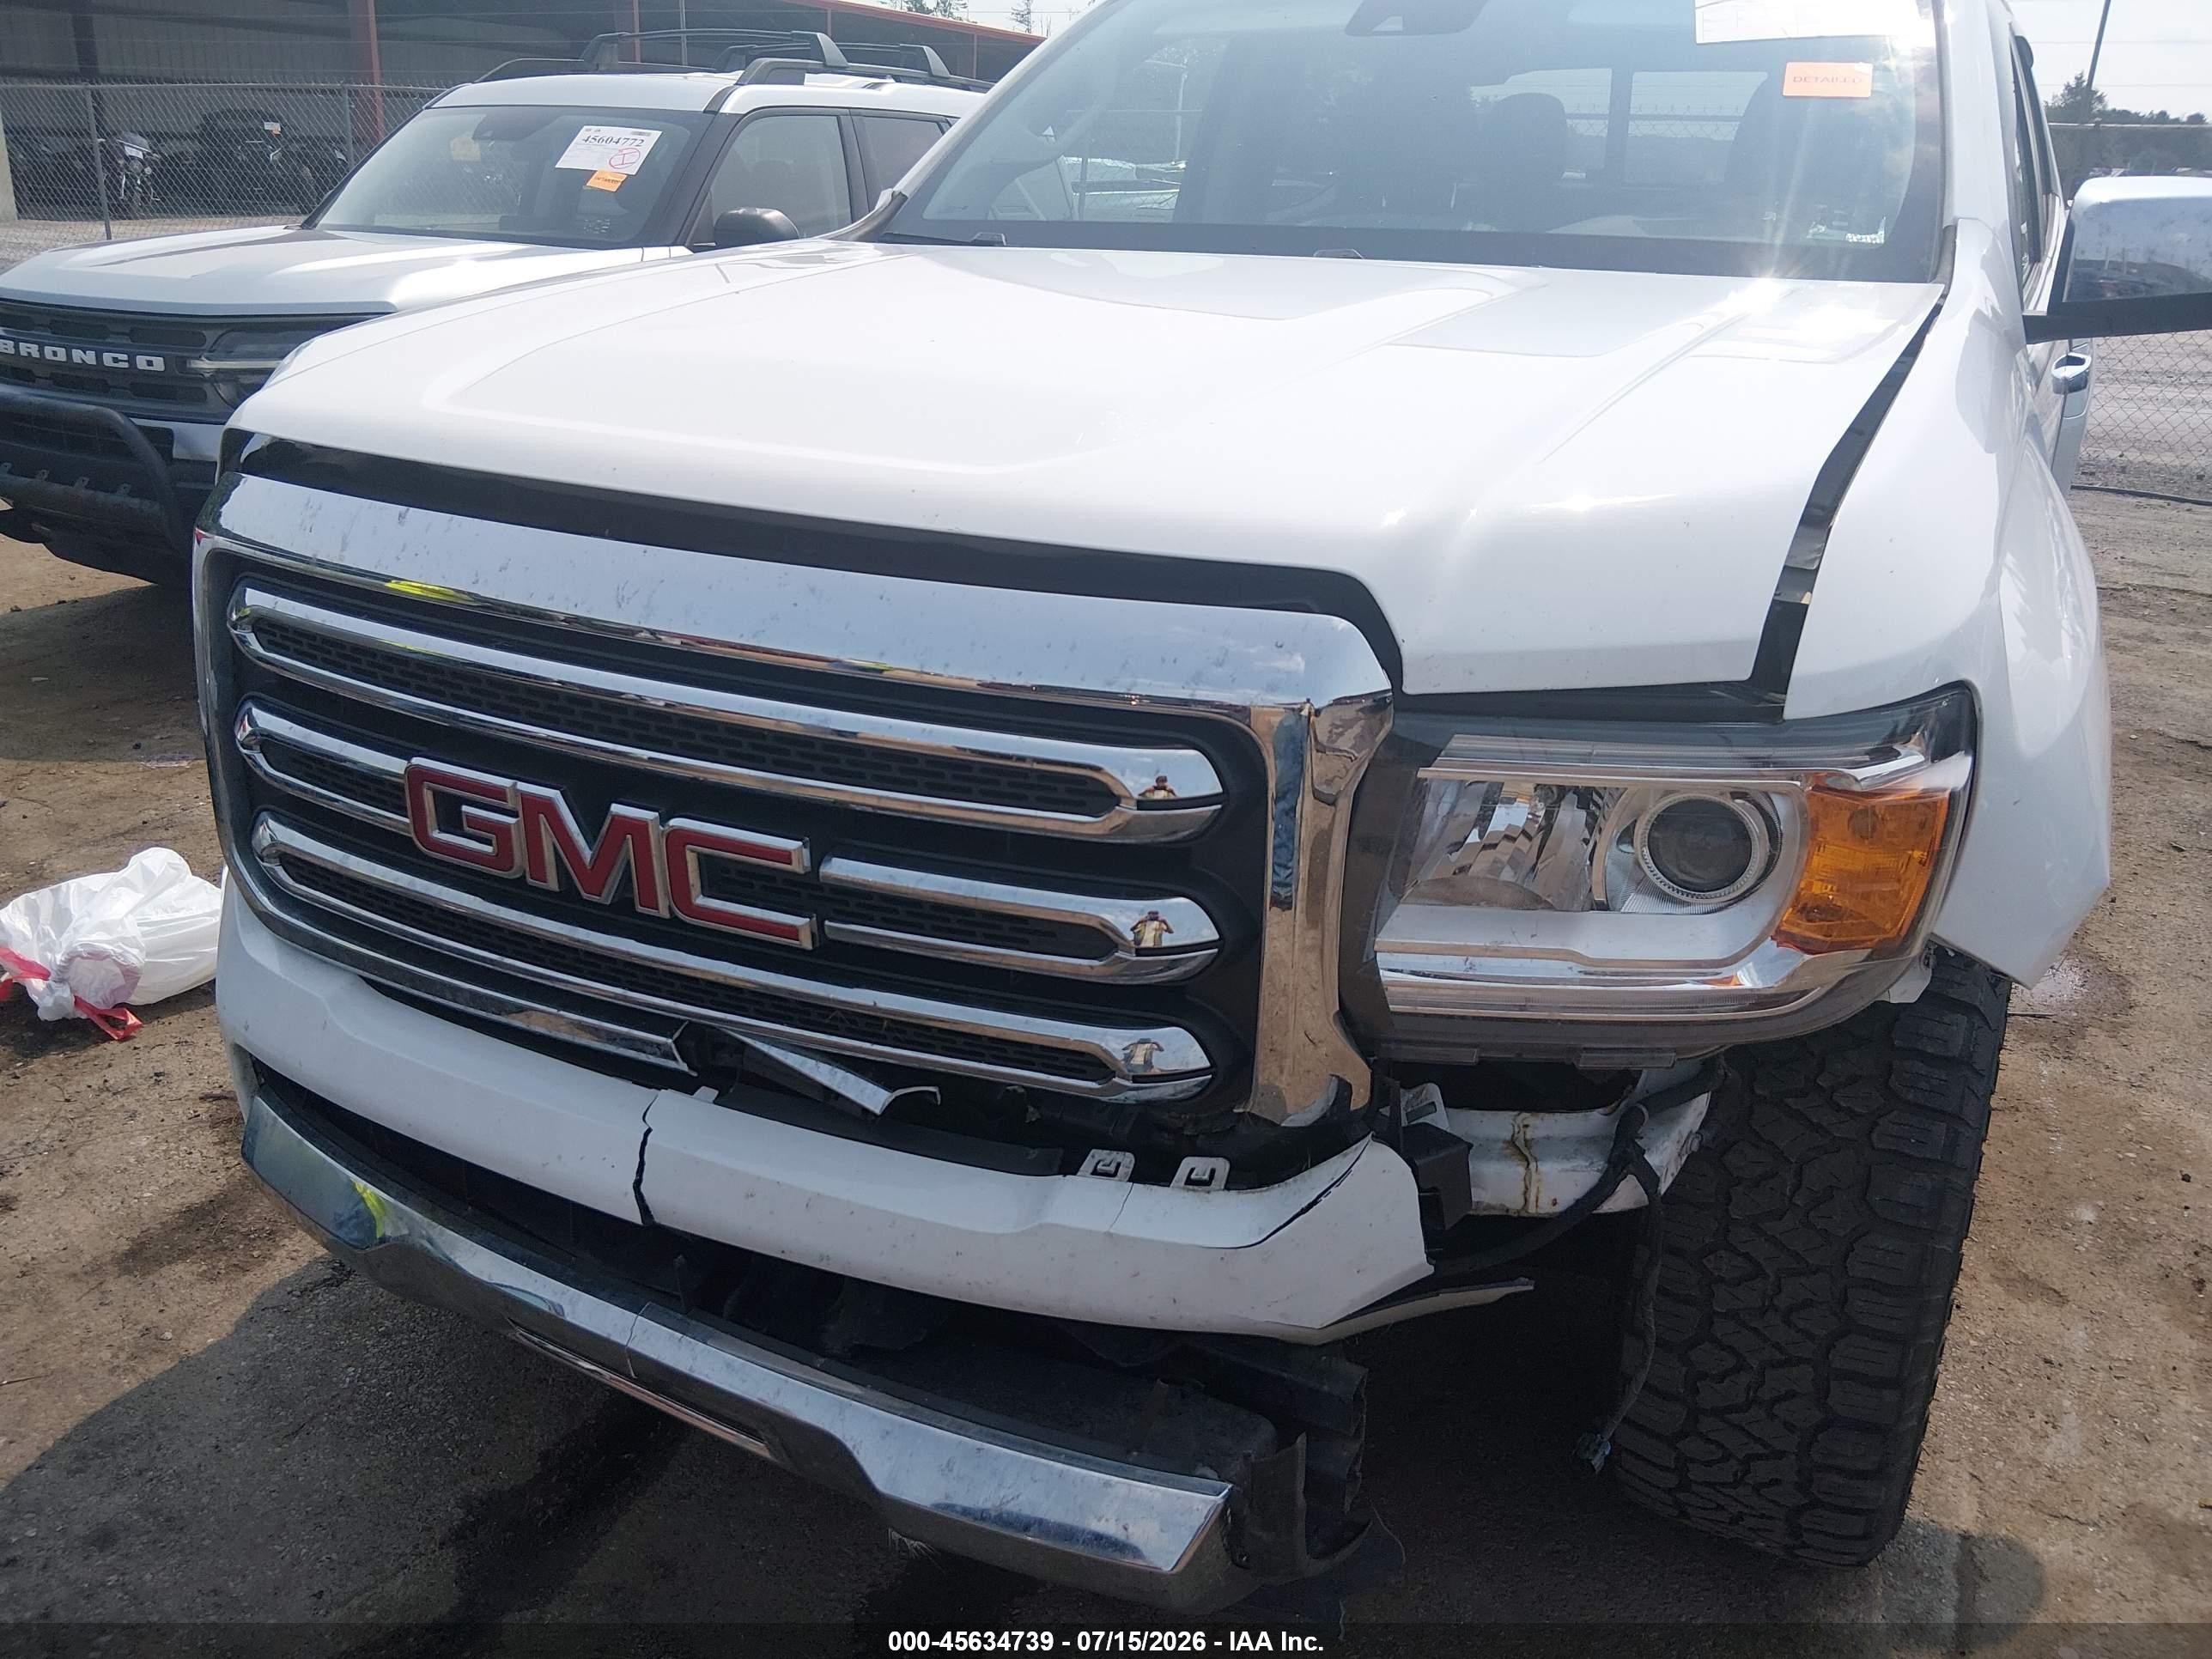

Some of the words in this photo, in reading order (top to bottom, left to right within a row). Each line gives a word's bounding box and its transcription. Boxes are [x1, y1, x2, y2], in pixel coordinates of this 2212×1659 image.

[1792, 75, 1863, 83] DETAILED
[582, 135, 645, 147] 45604772
[0, 338, 165, 371] BRONCO
[404, 757, 817, 951] GMC
